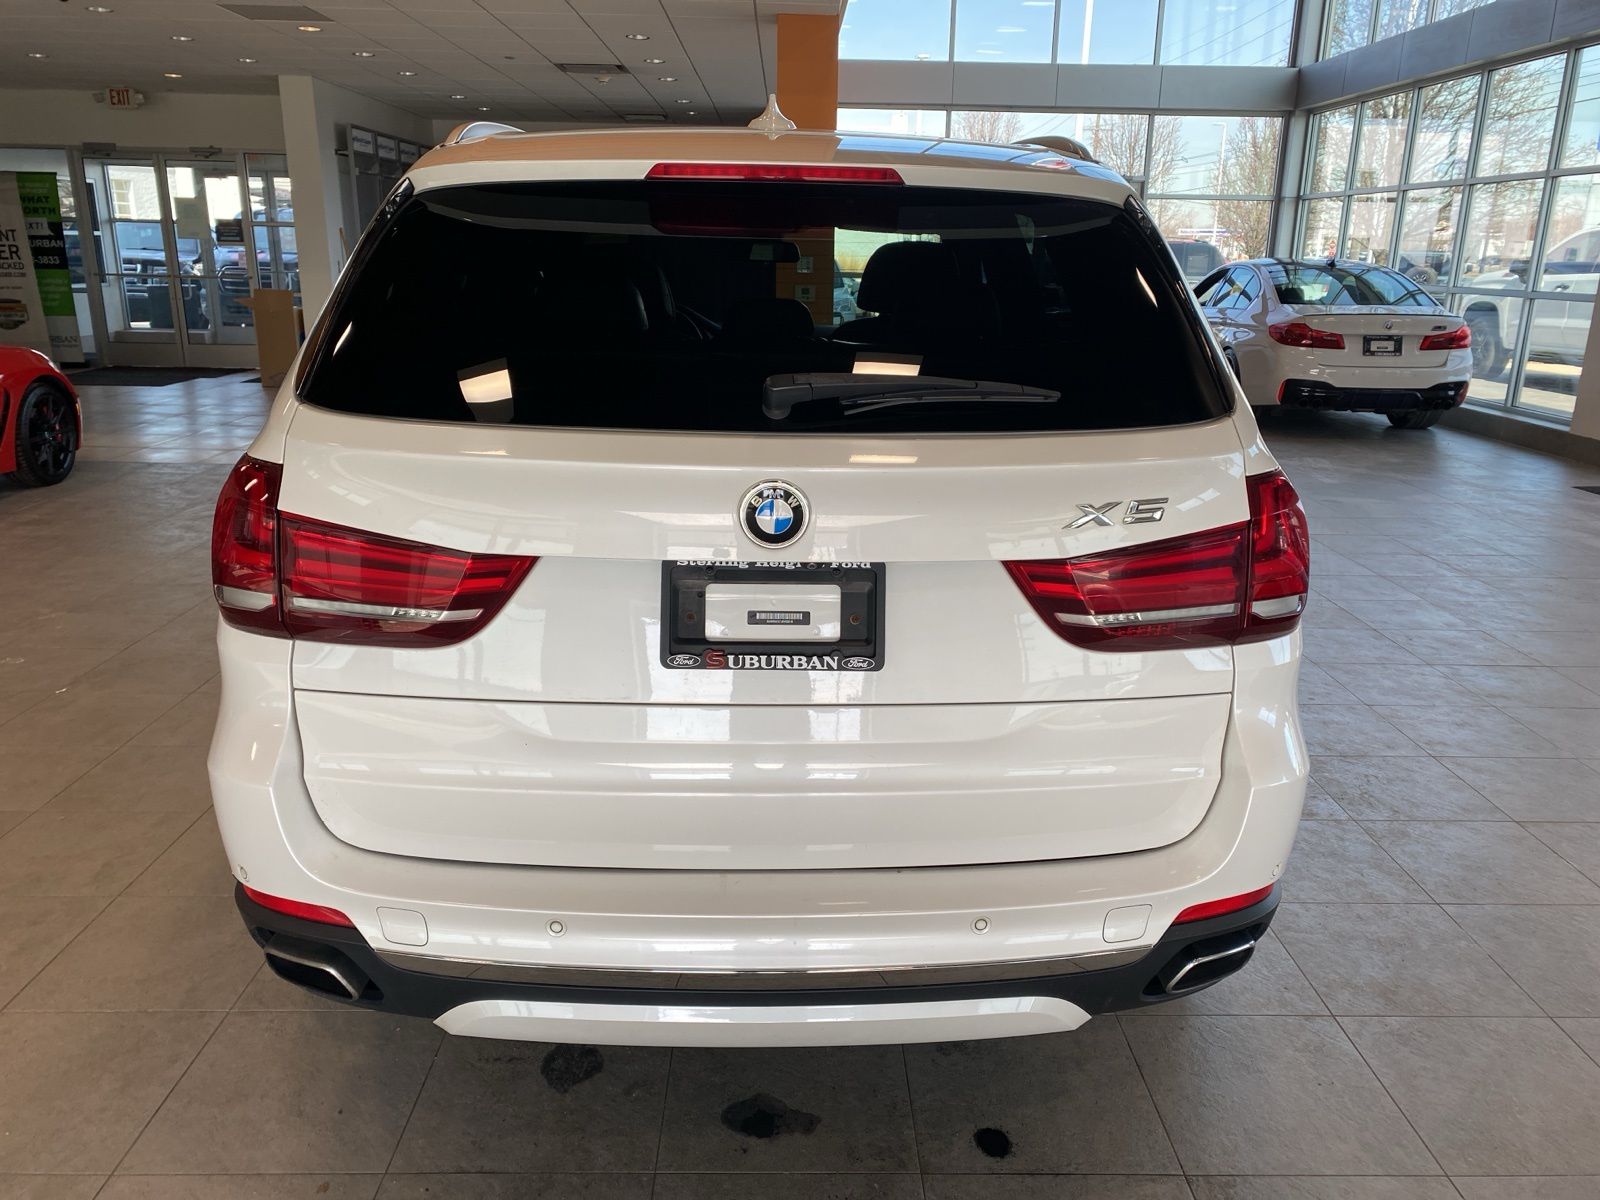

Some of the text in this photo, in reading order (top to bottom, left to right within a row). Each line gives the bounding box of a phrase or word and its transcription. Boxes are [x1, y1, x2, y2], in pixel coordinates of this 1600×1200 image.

[109, 88, 130, 106] EXIT
[26, 222, 44, 230] XT!
[750, 488, 801, 508] BMW
[1061, 497, 1169, 530] X5
[705, 650, 839, 670] SUBURBAN
